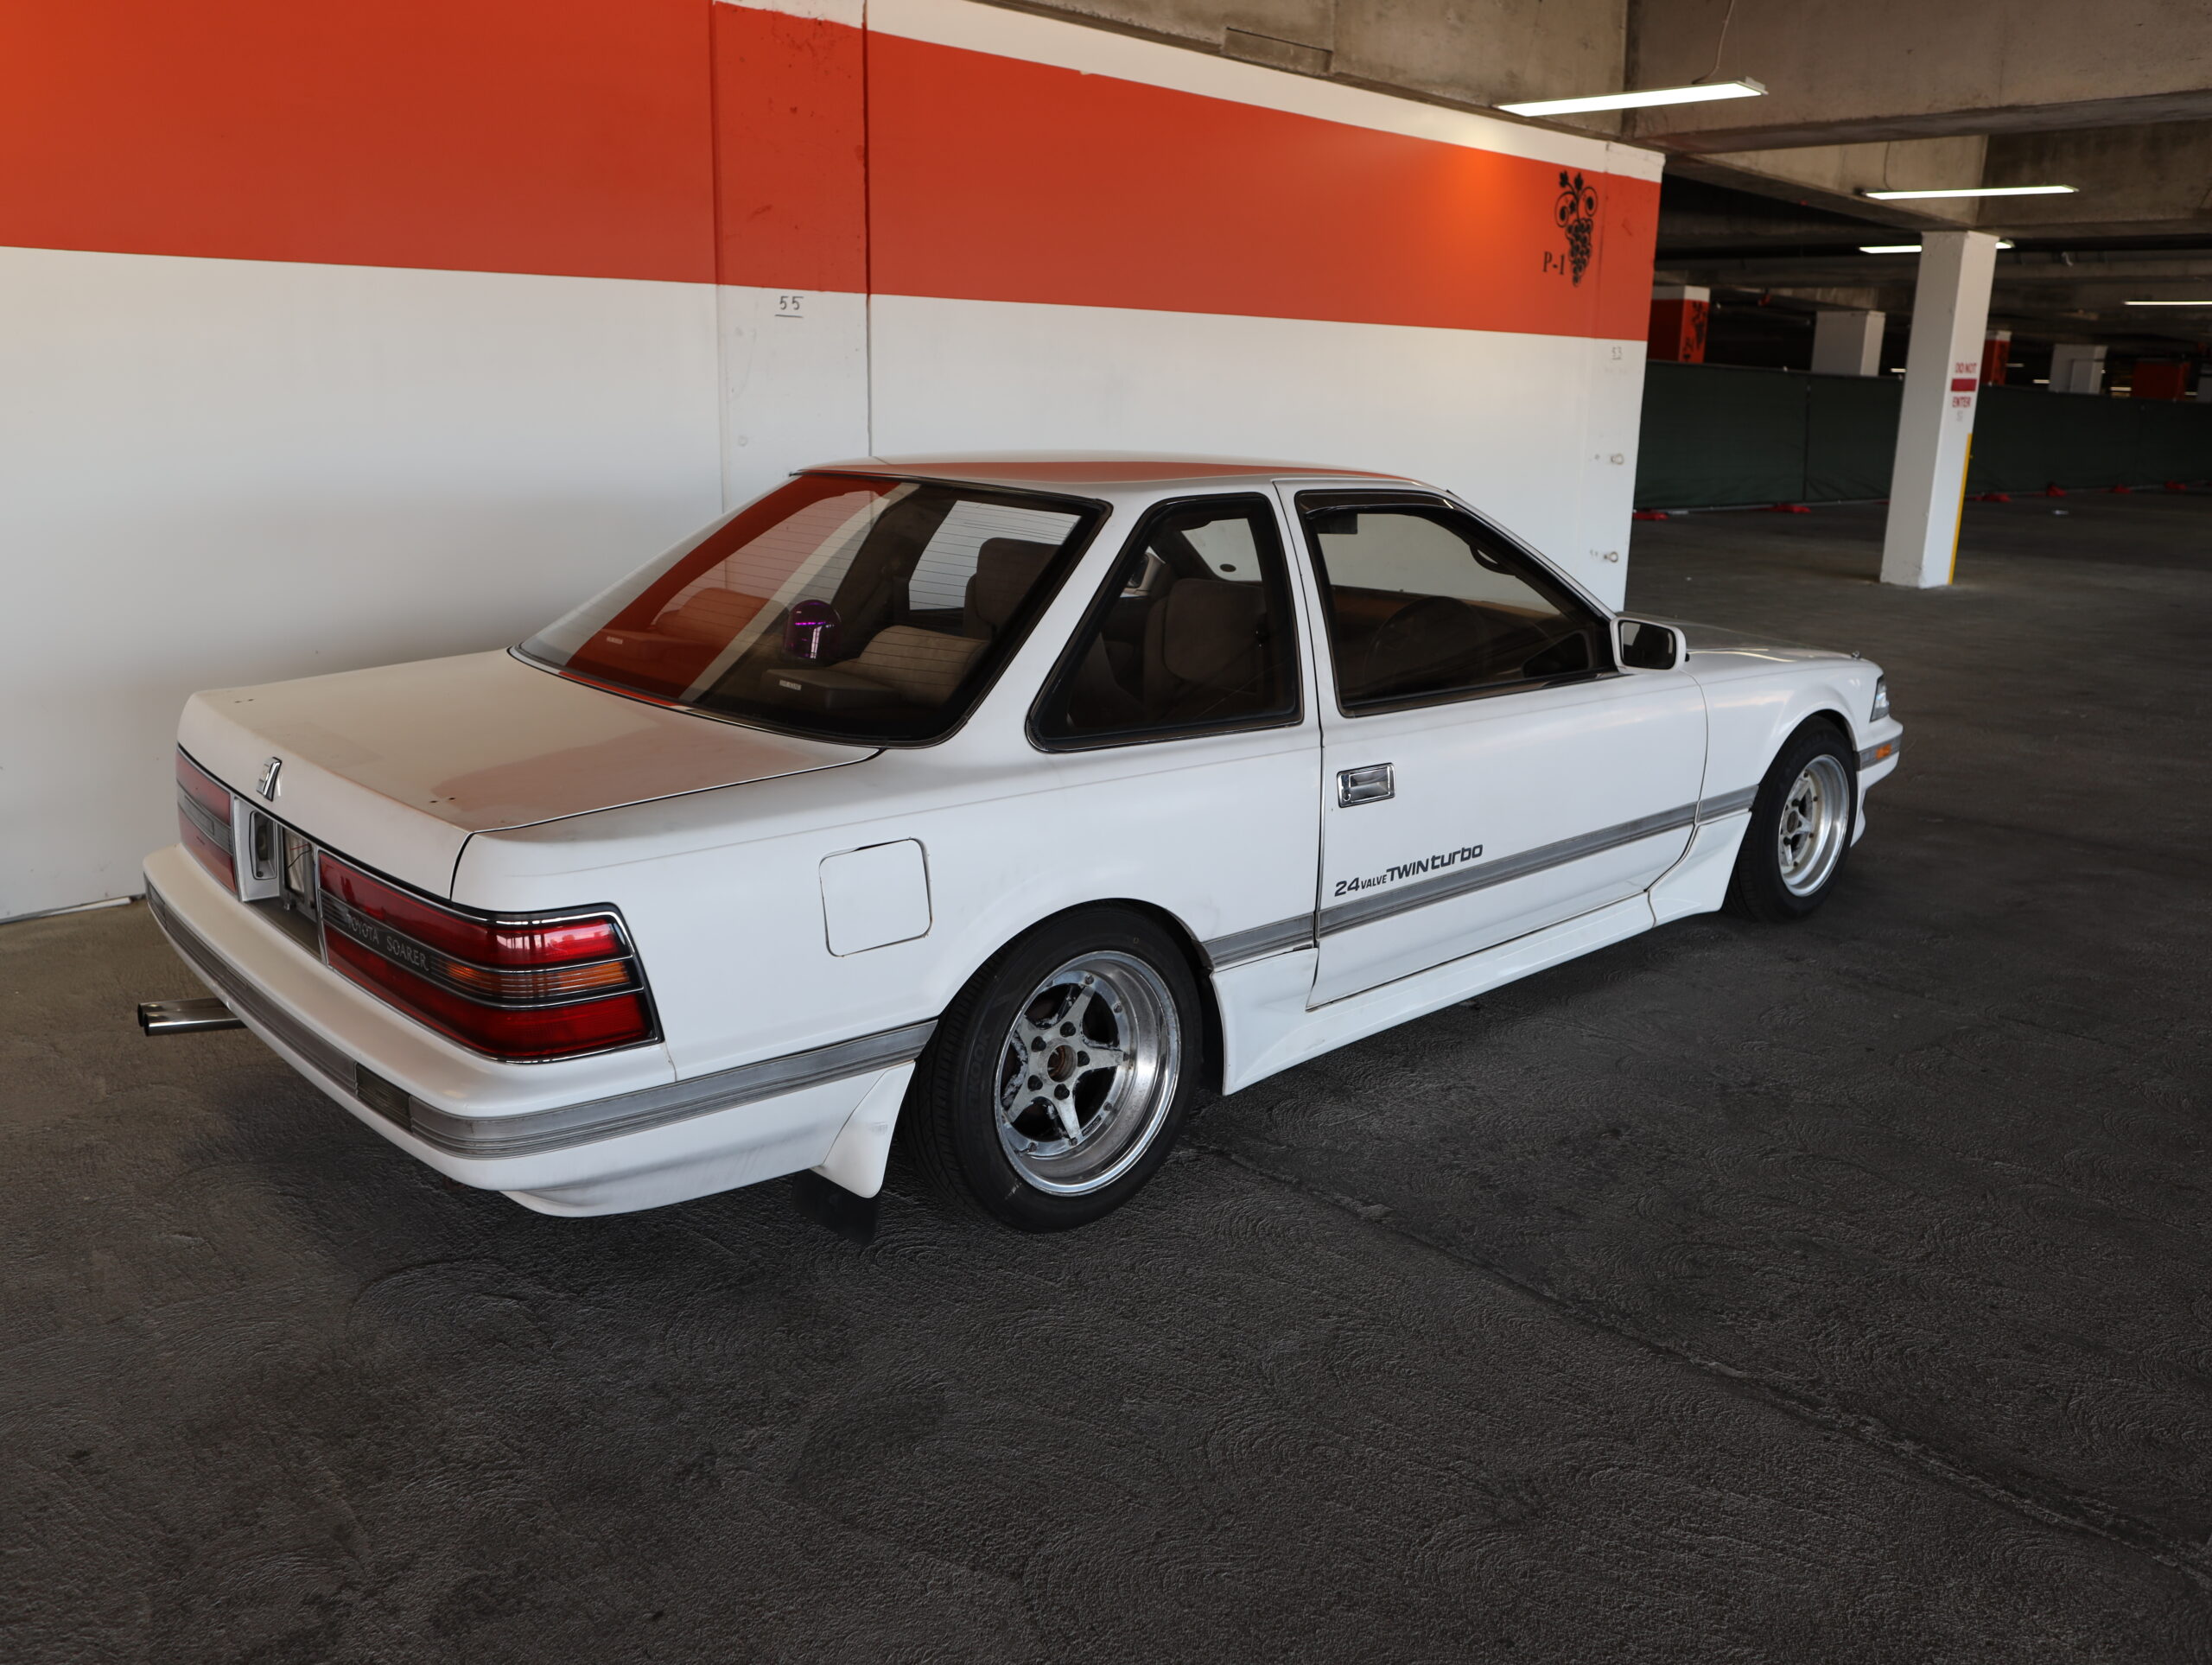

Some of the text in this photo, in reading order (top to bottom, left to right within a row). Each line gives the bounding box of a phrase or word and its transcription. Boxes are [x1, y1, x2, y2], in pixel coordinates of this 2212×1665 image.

[779, 295, 804, 310] 55
[1952, 396, 1972, 408] ENTER
[1334, 844, 1484, 897] 24 VALVE TWIN turbo
[346, 913, 429, 971] TOYOTA SOARER
